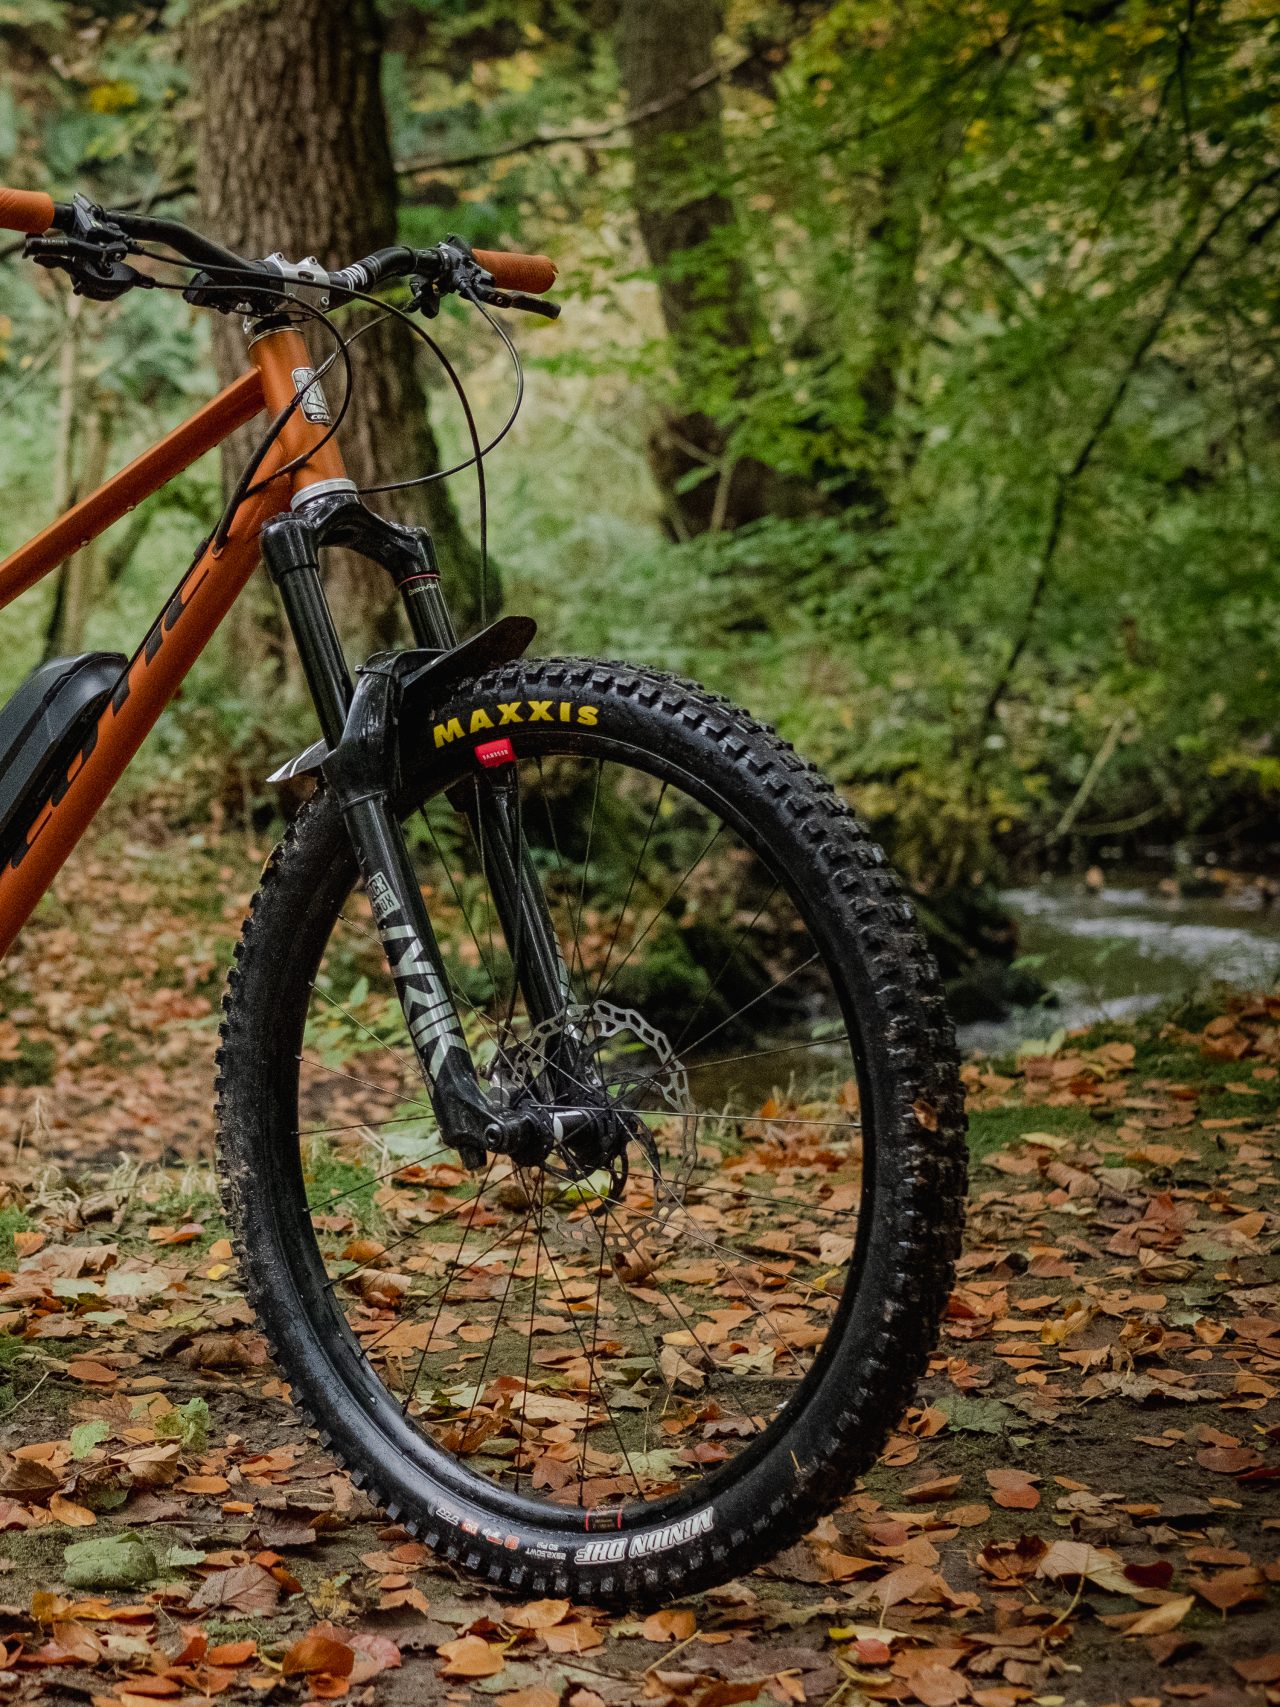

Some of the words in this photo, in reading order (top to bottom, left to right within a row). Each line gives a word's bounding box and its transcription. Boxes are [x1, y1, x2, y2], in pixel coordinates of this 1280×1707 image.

[433, 700, 600, 749] MAXXIS
[574, 1538, 629, 1565] DHF
[629, 1505, 715, 1558] MINION
